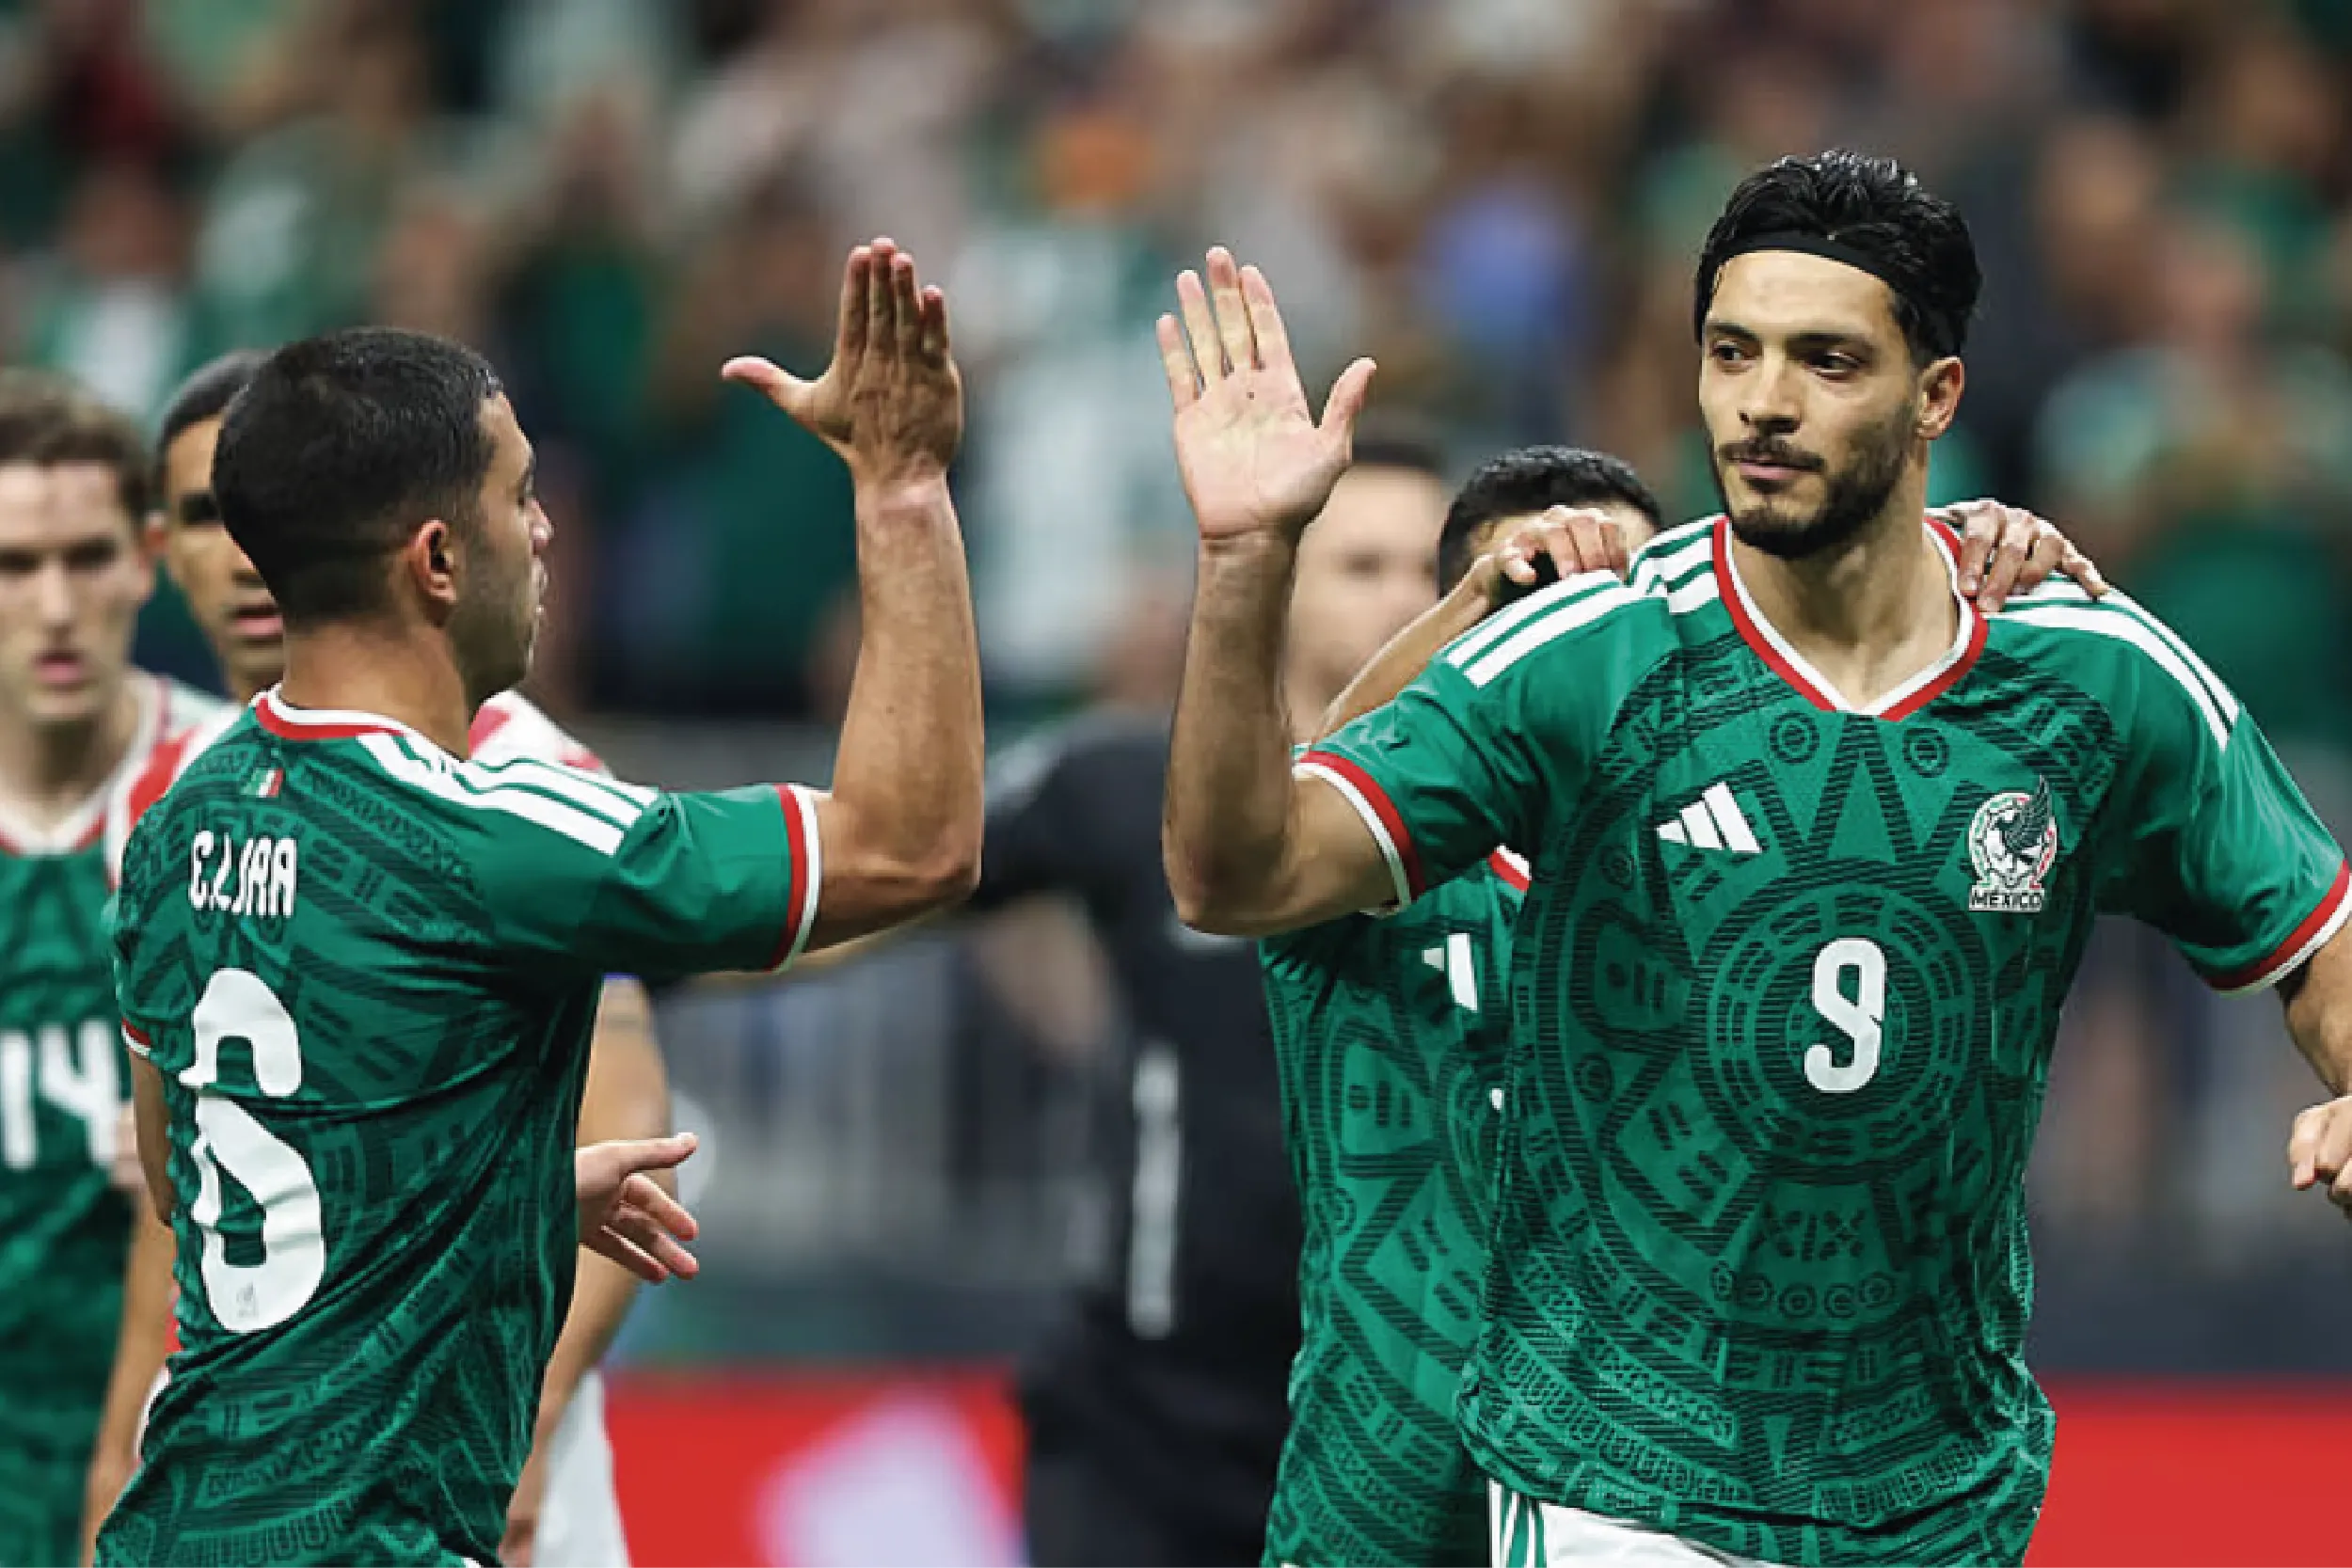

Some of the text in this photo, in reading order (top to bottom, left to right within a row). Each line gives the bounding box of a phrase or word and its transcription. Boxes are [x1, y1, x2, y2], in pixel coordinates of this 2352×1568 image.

[1804, 937, 1885, 1091] 9
[0, 1020, 118, 1168] 14
[179, 967, 325, 1334] 6
